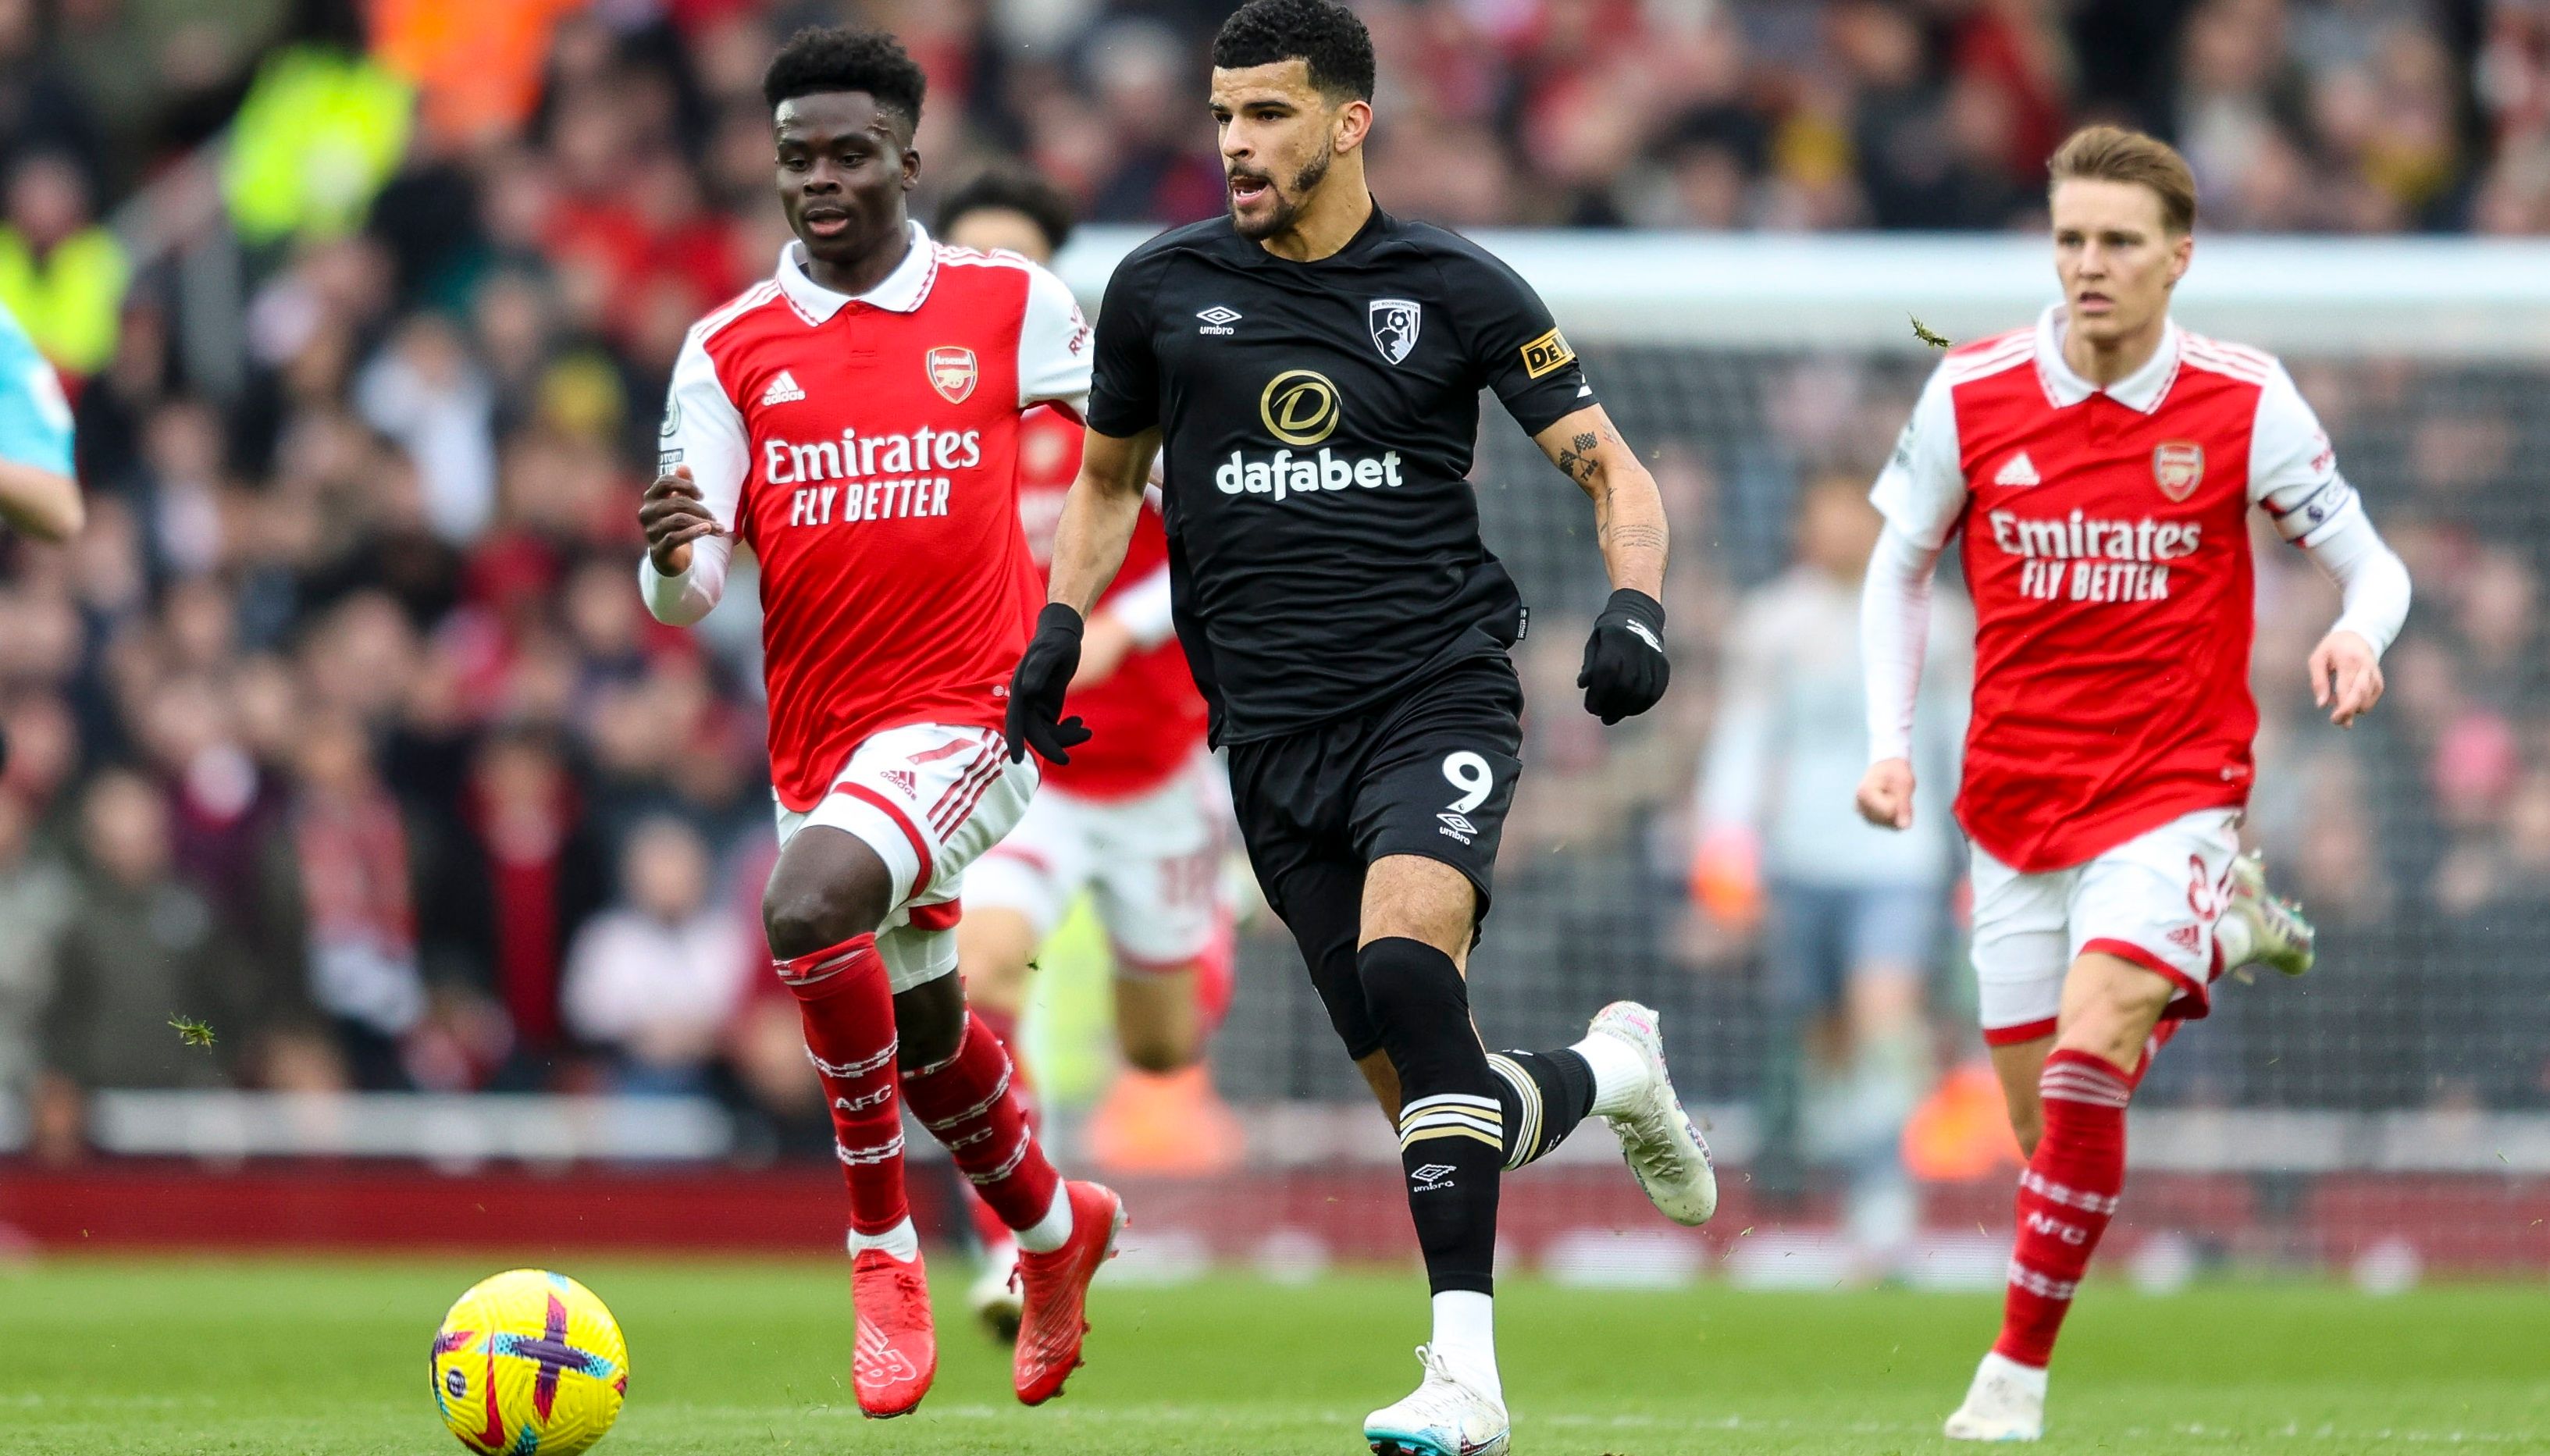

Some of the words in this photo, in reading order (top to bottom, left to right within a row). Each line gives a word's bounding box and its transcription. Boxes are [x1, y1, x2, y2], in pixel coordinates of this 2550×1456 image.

[1199, 326, 1234, 336] umbro
[934, 356, 970, 365] Arsenal
[762, 390, 806, 406] adidas
[764, 425, 981, 484] Emirates
[1216, 447, 1403, 501] dafabet
[790, 487, 835, 527] FLY
[843, 477, 951, 522] BETTER
[1989, 507, 2202, 562] Emirates
[2021, 558, 2066, 600] FLY
[2071, 562, 2169, 603] BETTER
[880, 771, 917, 801] adidas
[1442, 750, 1493, 814] 9
[1439, 826, 1471, 845] umbro
[835, 1084, 892, 1112] AFC
[1413, 1180, 1455, 1193] umbro
[2027, 1211, 2087, 1245] AFC
